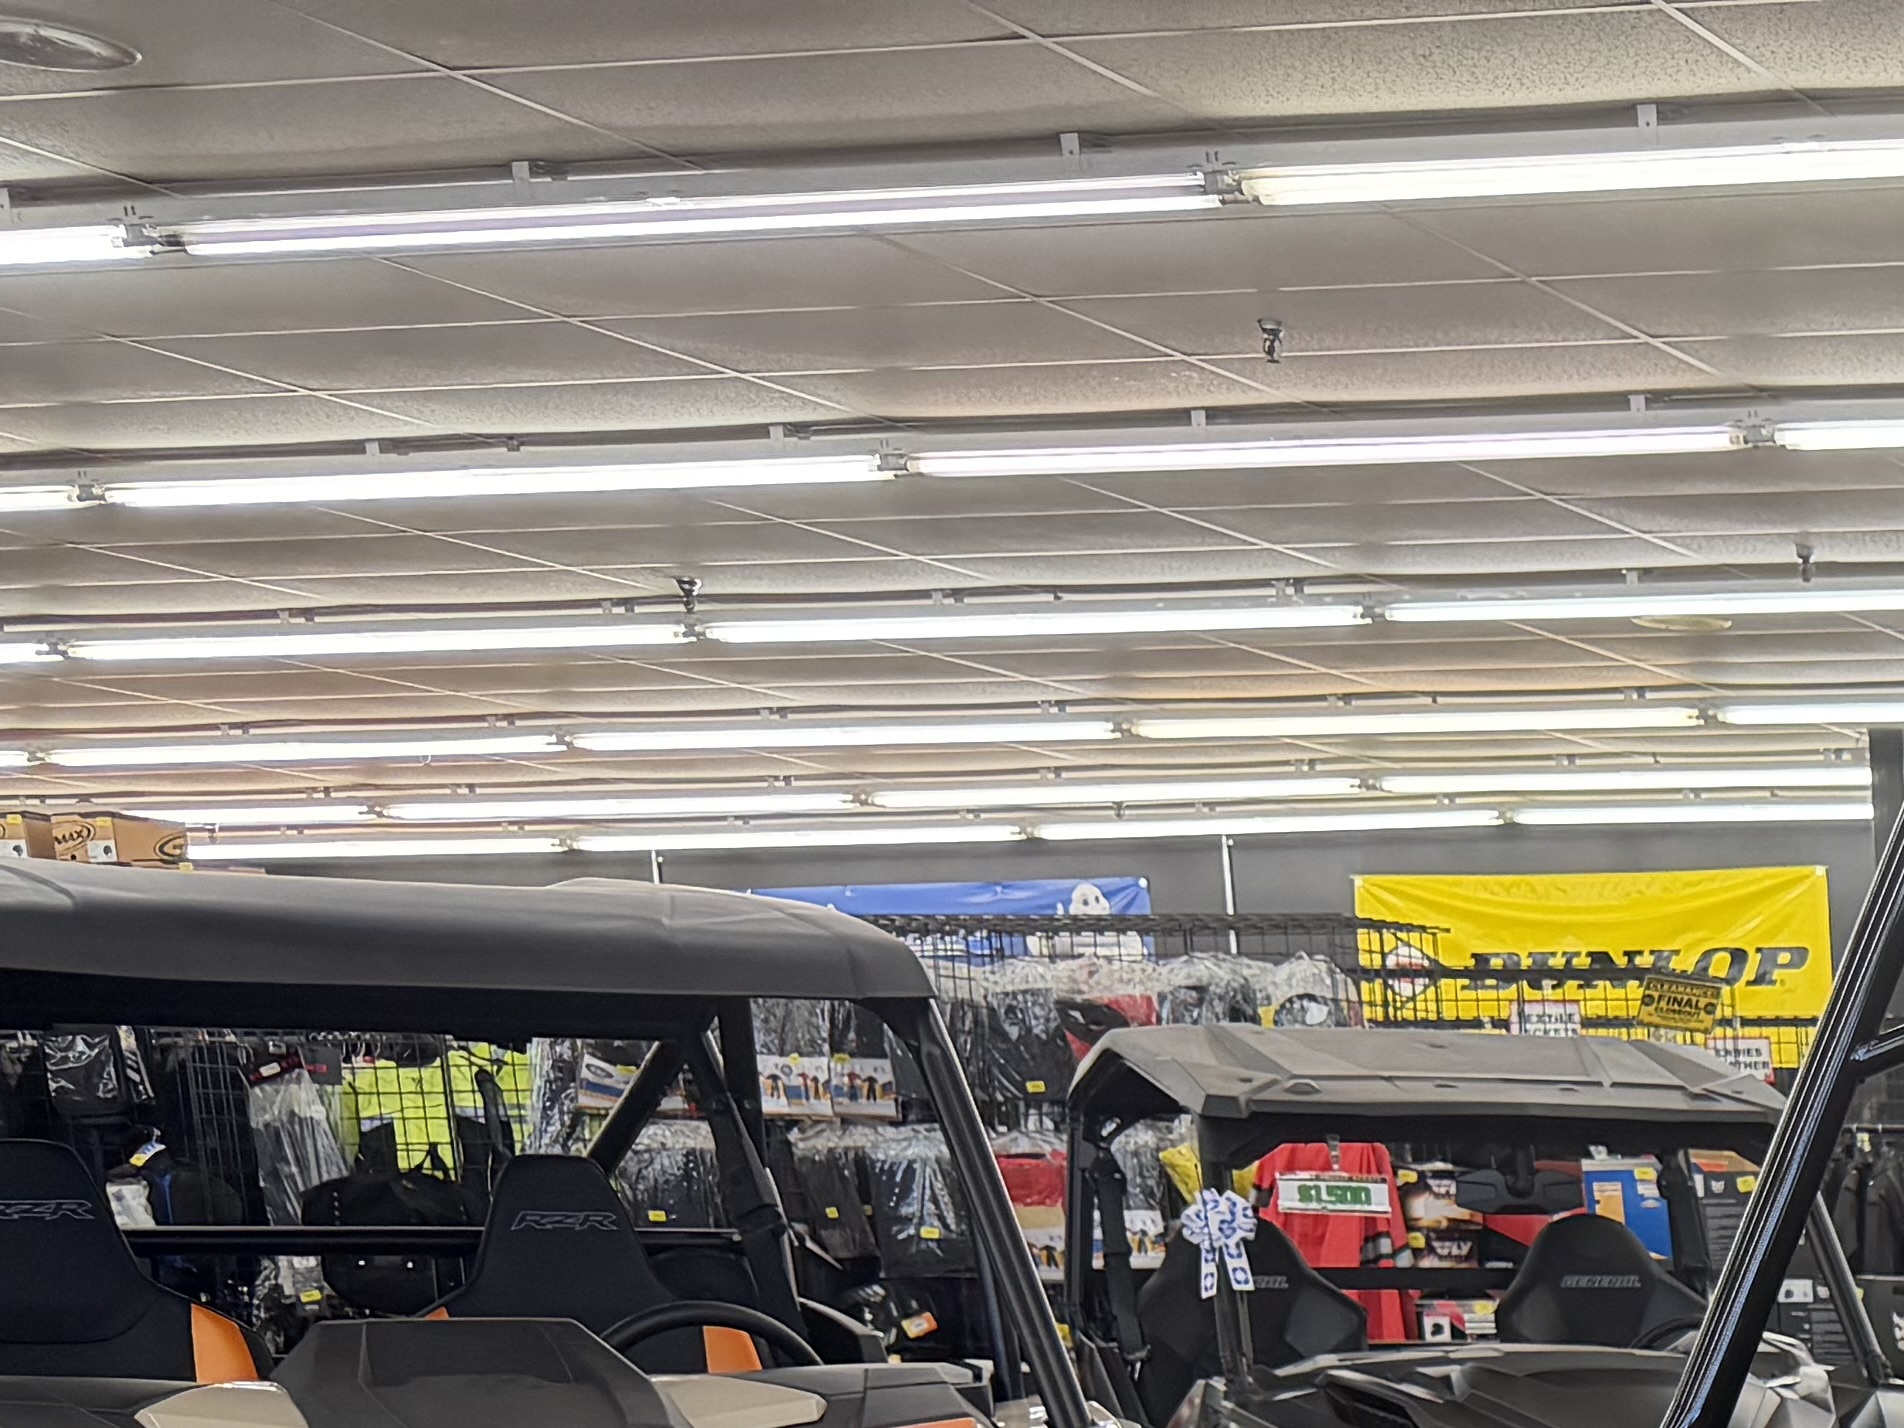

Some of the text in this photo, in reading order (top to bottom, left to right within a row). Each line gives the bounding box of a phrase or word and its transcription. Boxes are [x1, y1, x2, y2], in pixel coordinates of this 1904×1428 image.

[1460, 946, 1808, 991] DUNLOP
[1658, 994, 1702, 1011] FINAL
[1526, 1013, 1576, 1024] EXTILE
[510, 1210, 619, 1231] RZR
